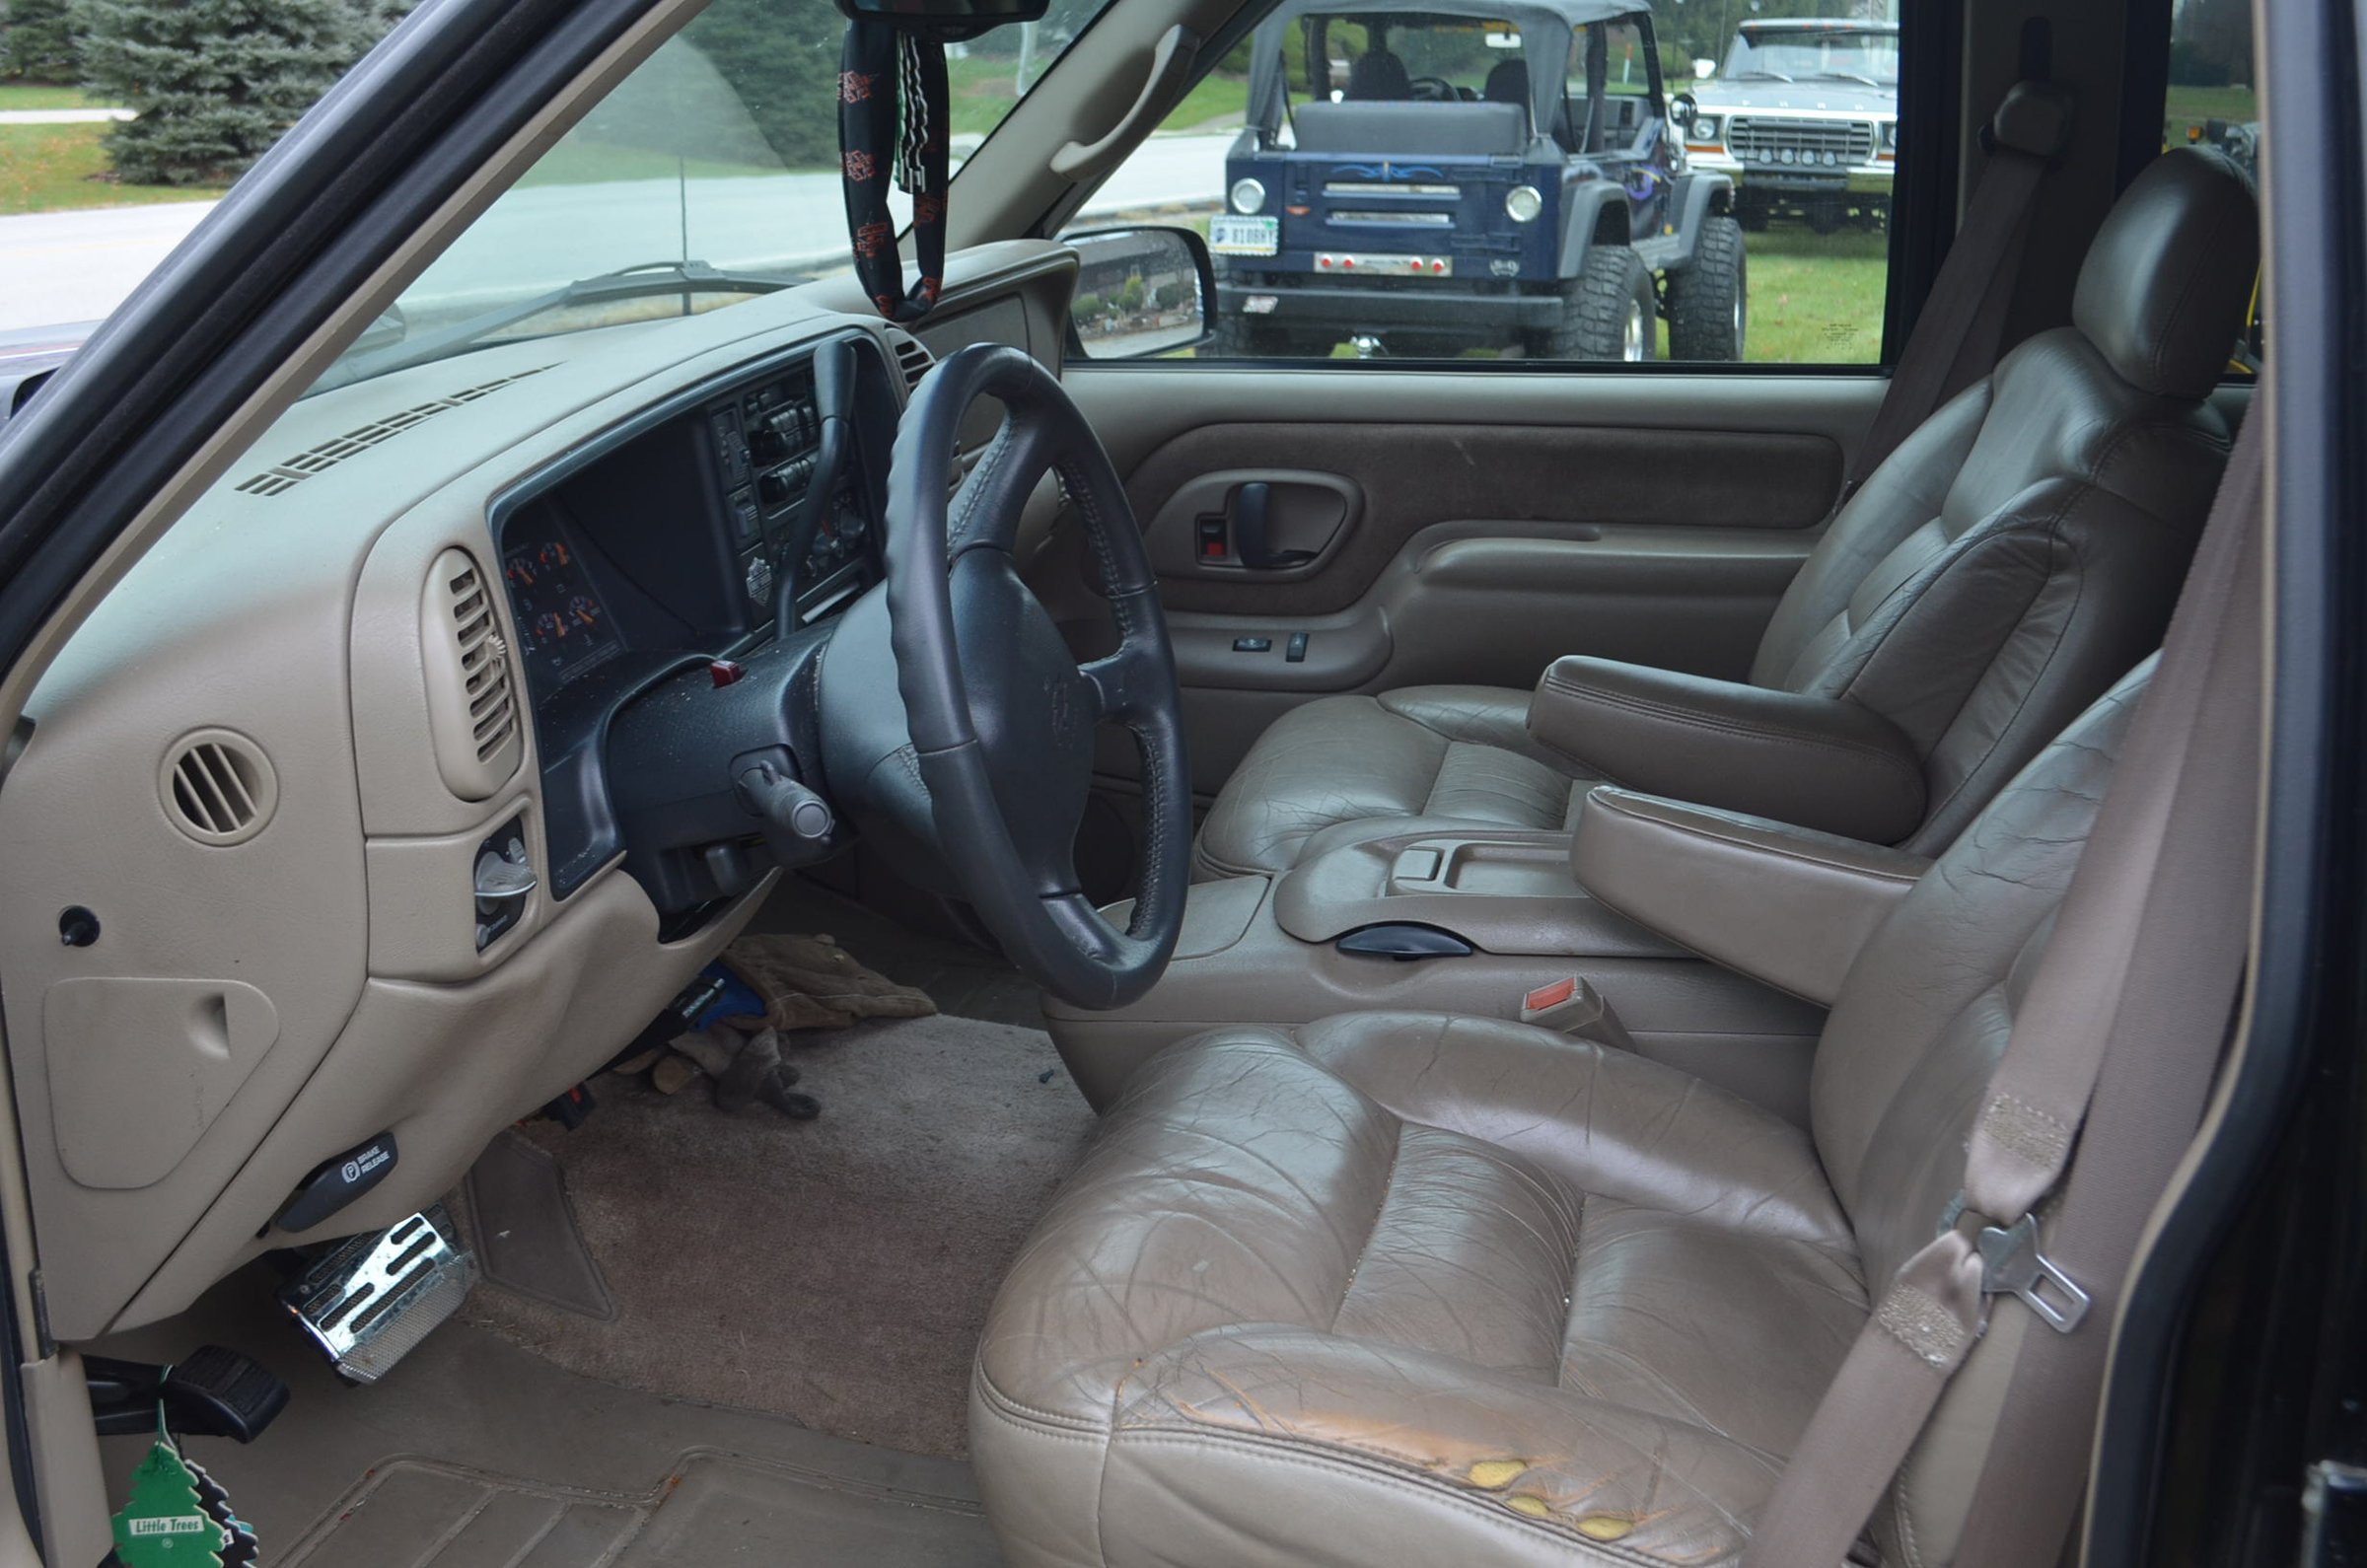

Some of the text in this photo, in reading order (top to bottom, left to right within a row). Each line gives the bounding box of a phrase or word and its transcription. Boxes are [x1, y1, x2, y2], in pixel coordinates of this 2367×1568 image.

[357, 1145, 381, 1165] BRAKE
[361, 1150, 391, 1174] RELEASE
[136, 1518, 199, 1533] Little Trees
